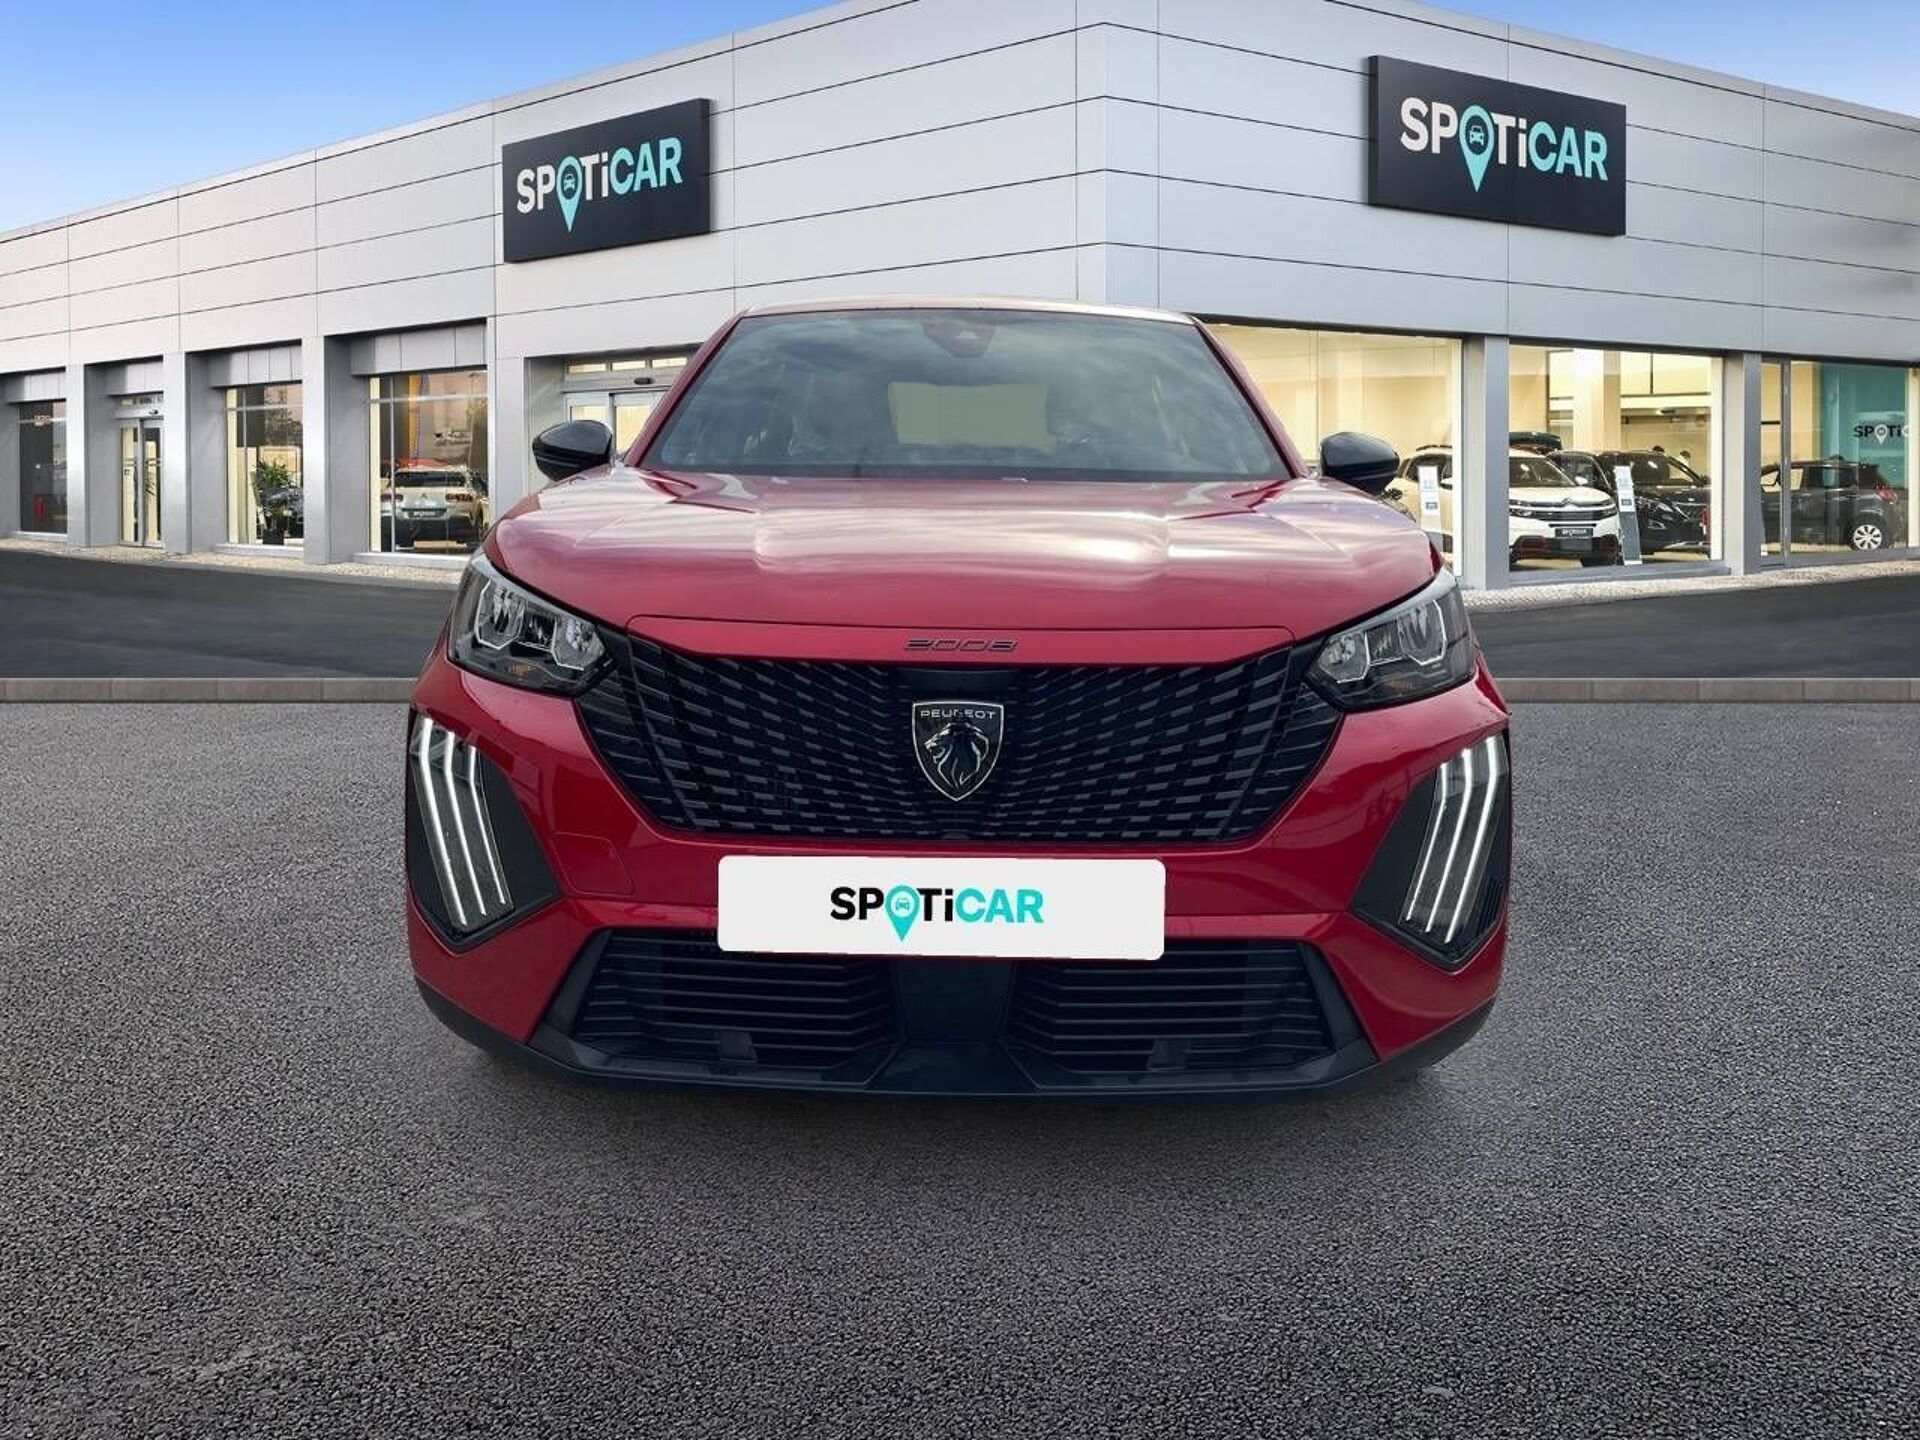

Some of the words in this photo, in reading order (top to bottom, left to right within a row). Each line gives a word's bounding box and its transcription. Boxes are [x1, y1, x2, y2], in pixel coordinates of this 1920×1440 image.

[1400, 97, 1608, 192] SPOTiCAR
[516, 137, 683, 232] SPOTiCAR
[904, 639, 1018, 652] 2008
[830, 884, 1044, 942] SPOTiCAR
